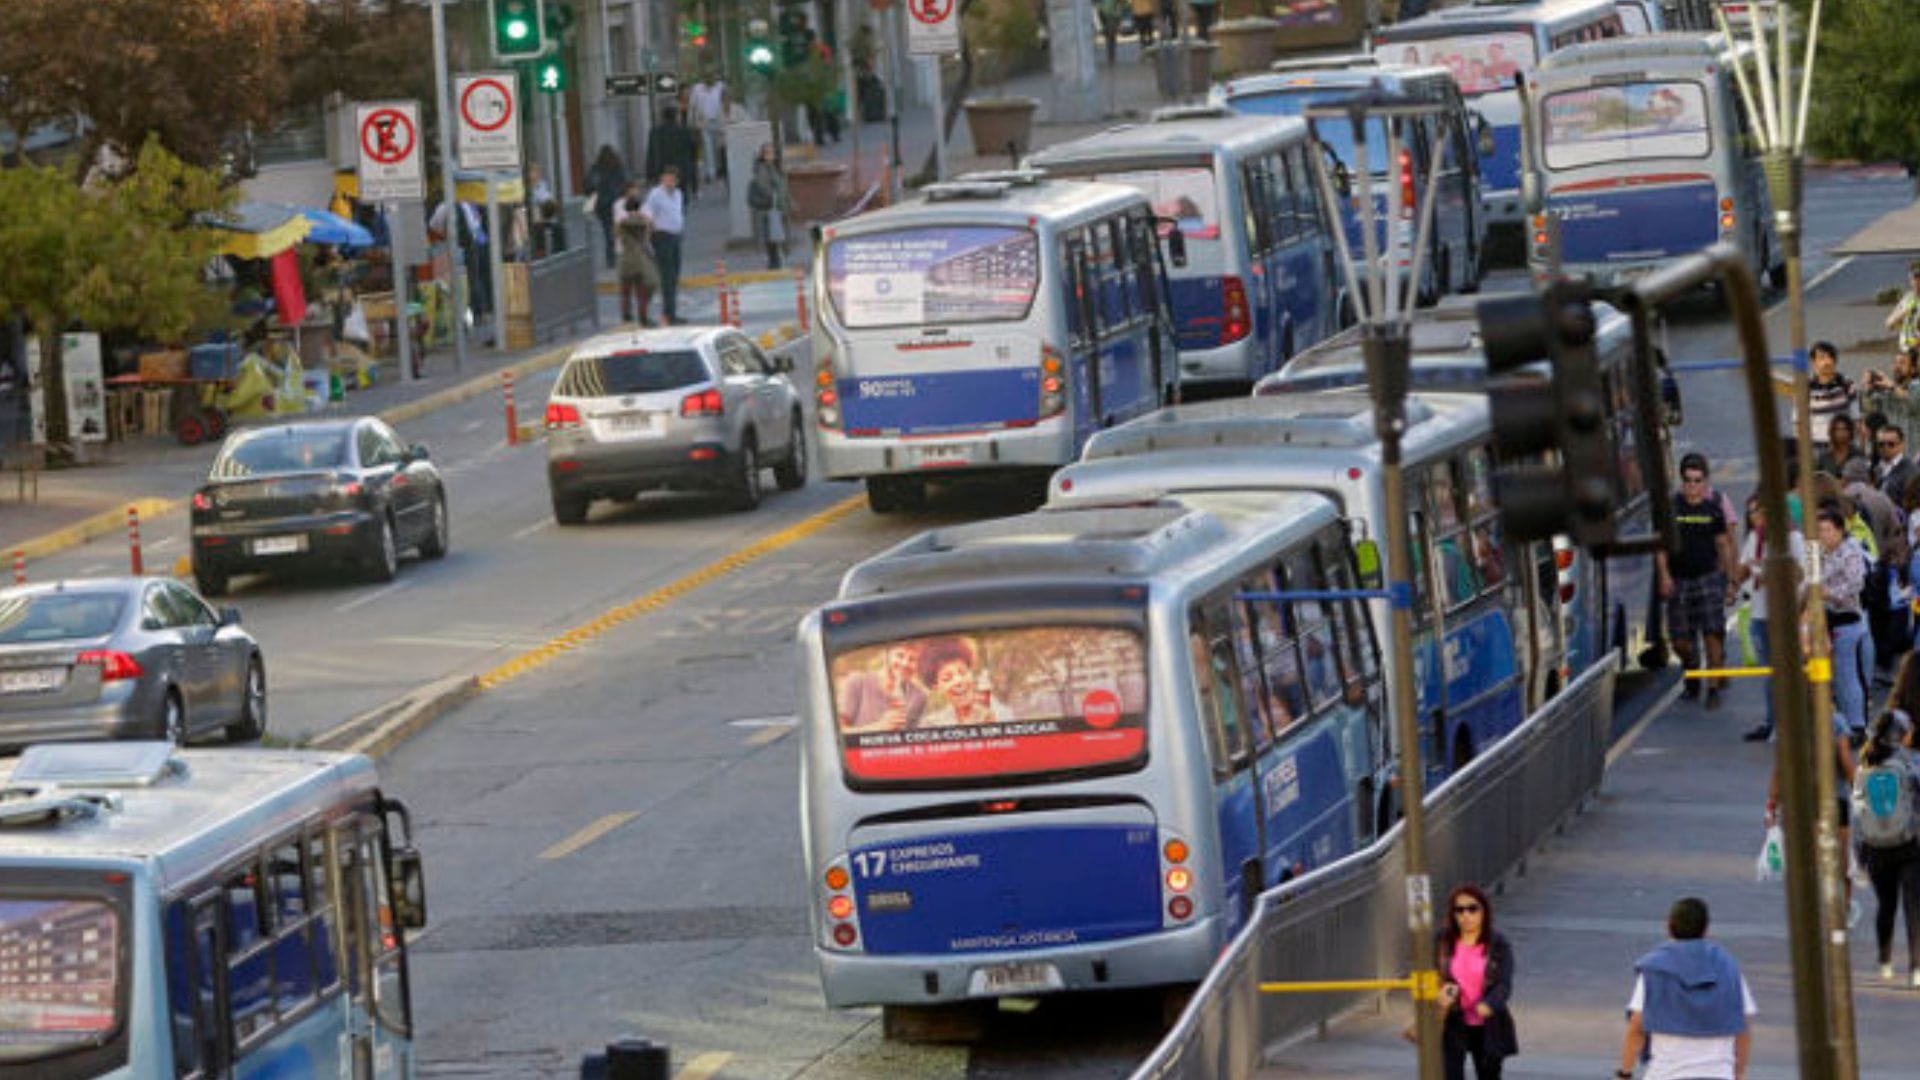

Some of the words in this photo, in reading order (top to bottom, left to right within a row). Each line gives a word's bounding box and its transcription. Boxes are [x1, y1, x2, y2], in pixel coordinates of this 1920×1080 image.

[905, 728, 979, 744] COCA-COLA
[891, 843, 955, 860] EXPRESOS
[854, 850, 887, 878] 17
[951, 934, 1019, 950] MANTENGA
